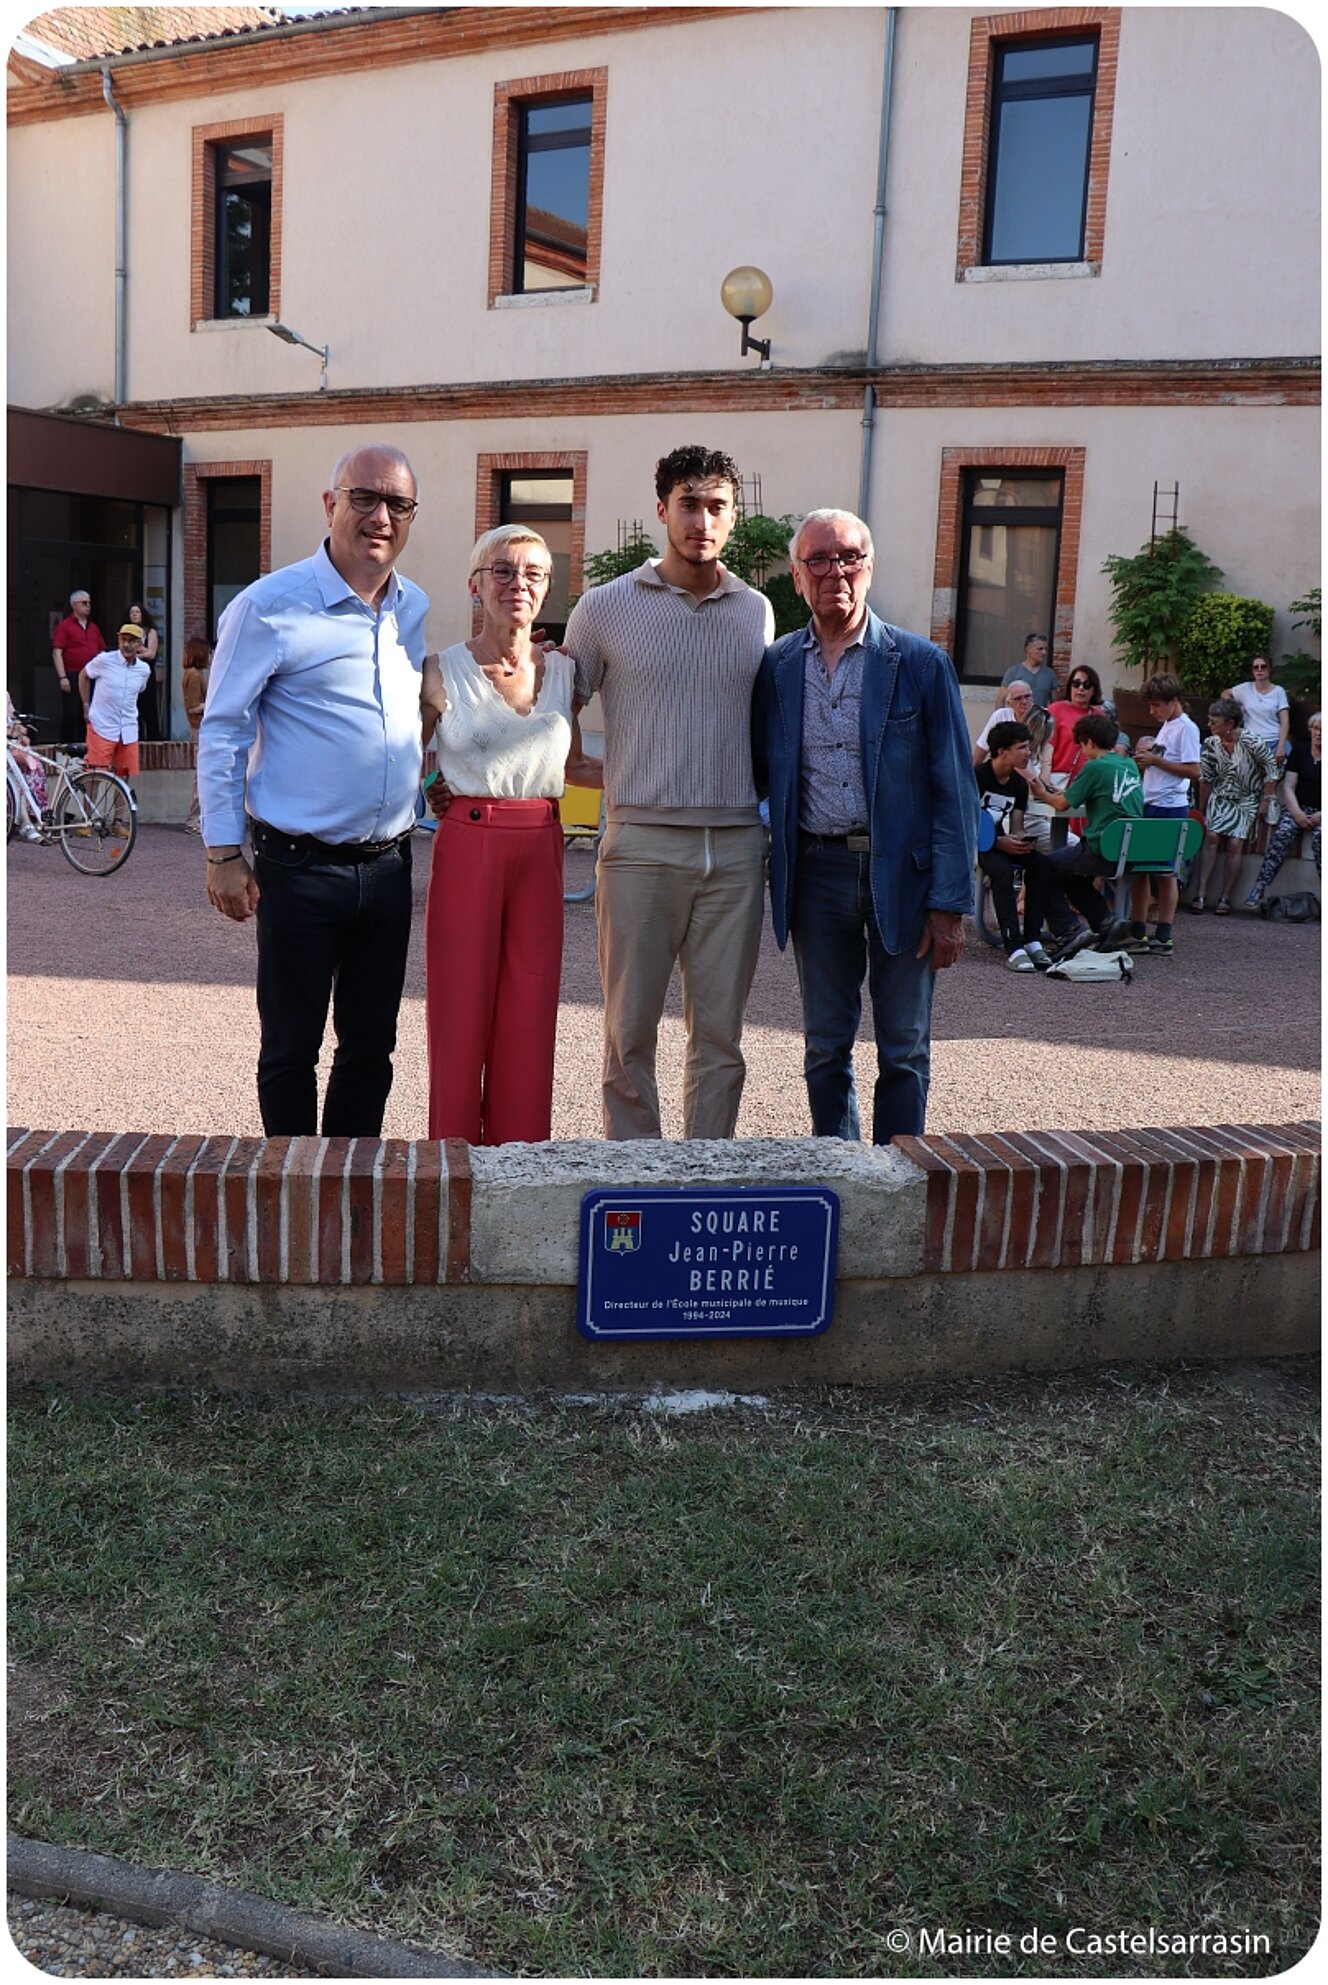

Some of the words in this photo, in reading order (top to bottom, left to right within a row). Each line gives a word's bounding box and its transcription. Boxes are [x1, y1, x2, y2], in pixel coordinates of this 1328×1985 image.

[690, 1210, 780, 1235] SQUARE
[668, 1240, 799, 1263] Jean-Pierre
[689, 1264, 775, 1291] BERRIÉ
[604, 1300, 649, 1310] Directeur
[651, 1300, 663, 1309] de
[666, 1298, 698, 1309] l'École
[701, 1298, 752, 1308] municipale
[755, 1298, 766, 1307] de
[768, 1297, 808, 1307] musique
[683, 1310, 731, 1320] 1994-2024
